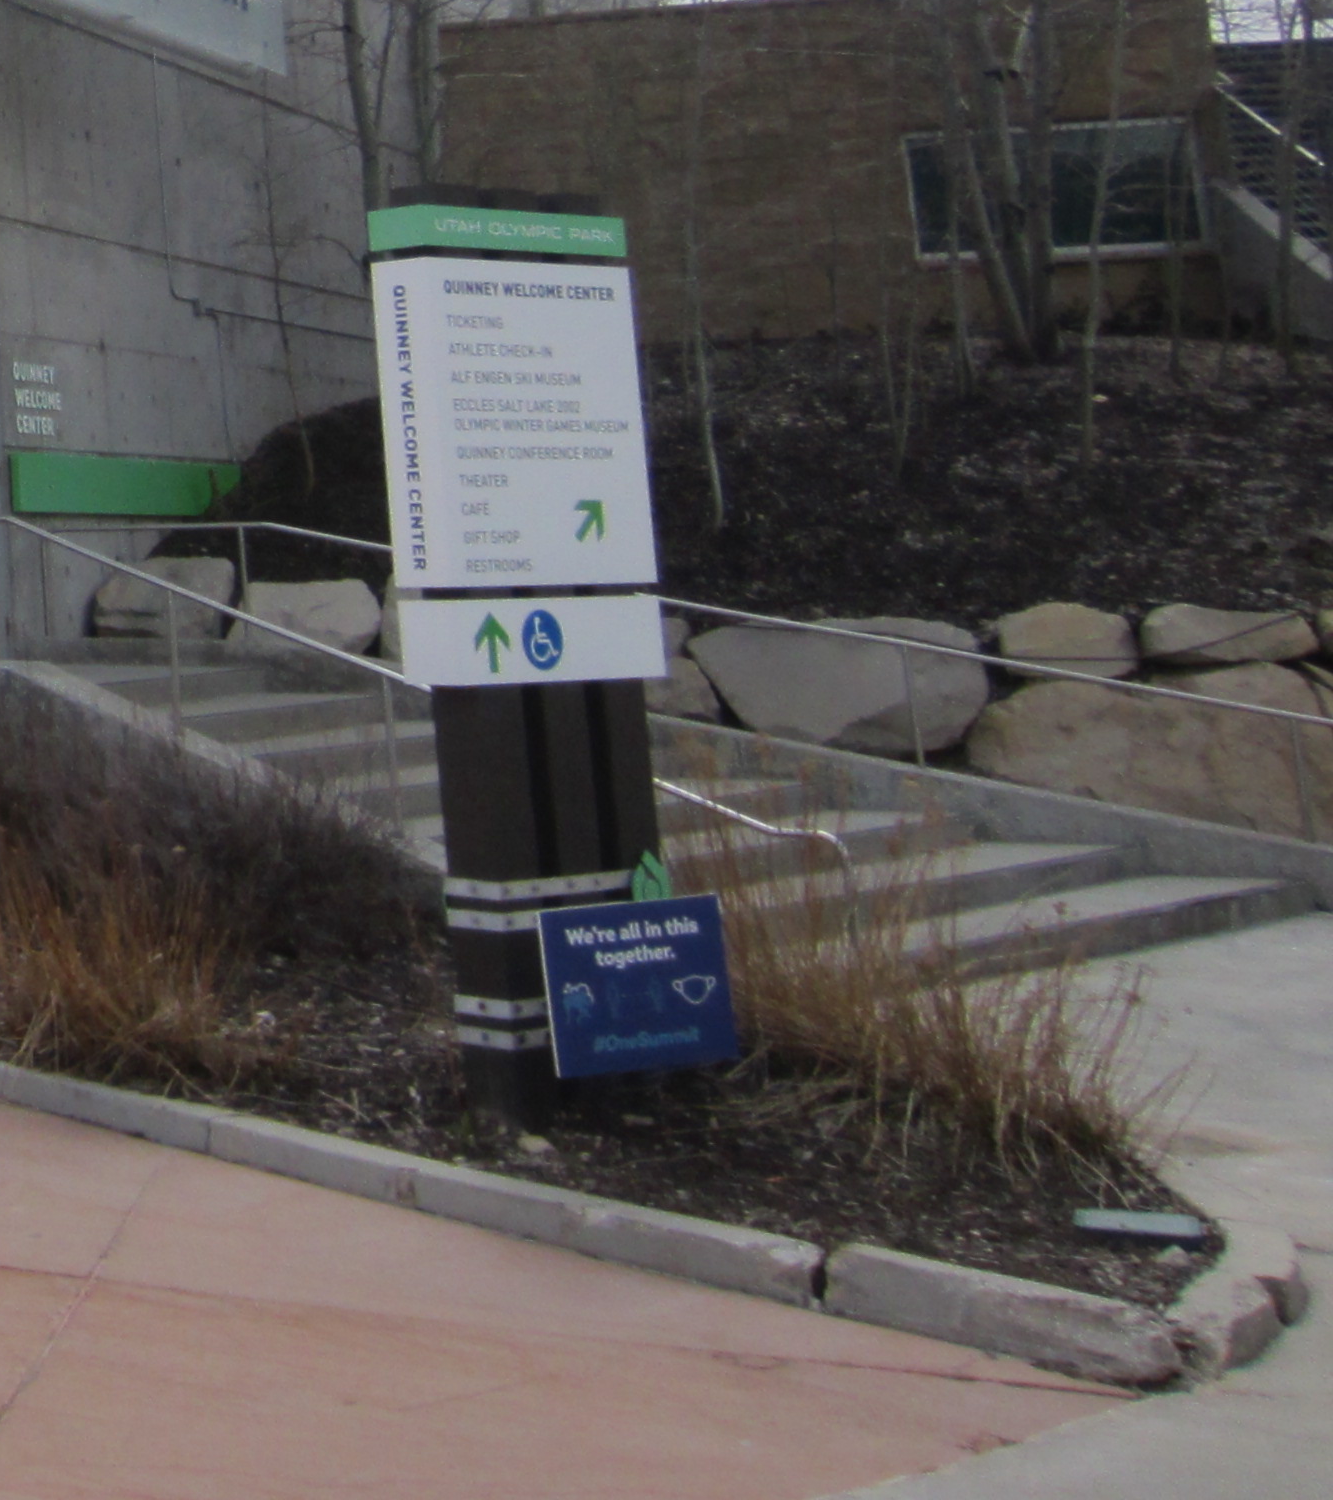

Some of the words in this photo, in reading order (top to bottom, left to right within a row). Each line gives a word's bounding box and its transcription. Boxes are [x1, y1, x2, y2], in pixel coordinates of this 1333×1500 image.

[435, 218, 482, 234] UTAH
[488, 221, 562, 240] OLYMPIC
[569, 227, 615, 243] PARK
[443, 279, 499, 296] QUINNEY
[502, 283, 564, 299] WELCOME
[566, 286, 614, 301] CENTER
[393, 285, 413, 374] QUINNEY
[446, 314, 504, 329] TICKETING
[448, 342, 498, 357] ATHLETE
[499, 343, 553, 358] CHECK-IN
[12, 360, 57, 384] QUINNEY
[451, 371, 471, 384] ALF
[475, 371, 512, 385] ENGEN
[515, 371, 532, 385] SKI
[535, 372, 582, 386] MUSEUM
[14, 388, 62, 411] WELCOME
[452, 399, 496, 412] ECCLES
[497, 399, 523, 413] SALT
[527, 400, 555, 413] LAKE
[557, 401, 581, 414] 2002
[16, 415, 57, 436] CENTER
[400, 381, 421, 482] WELCOME
[454, 419, 501, 432] OLYMPIC
[502, 419, 545, 432] WINTER
[546, 420, 582, 433] GAMES
[583, 420, 629, 433] MUSEUM
[457, 446, 505, 460] QUINNEY
[508, 446, 582, 460] CONFERENCE
[583, 447, 614, 460] ROOM
[459, 474, 509, 488] THEATER
[408, 489, 426, 570] CENTER
[463, 531, 487, 544] GIFT
[490, 531, 521, 544] SHOP
[466, 559, 533, 573] RESTROOMS
[564, 926, 616, 946] We're
[620, 922, 642, 940] all
[644, 920, 662, 938] in
[664, 916, 700, 935] this
[594, 945, 676, 969] together.
